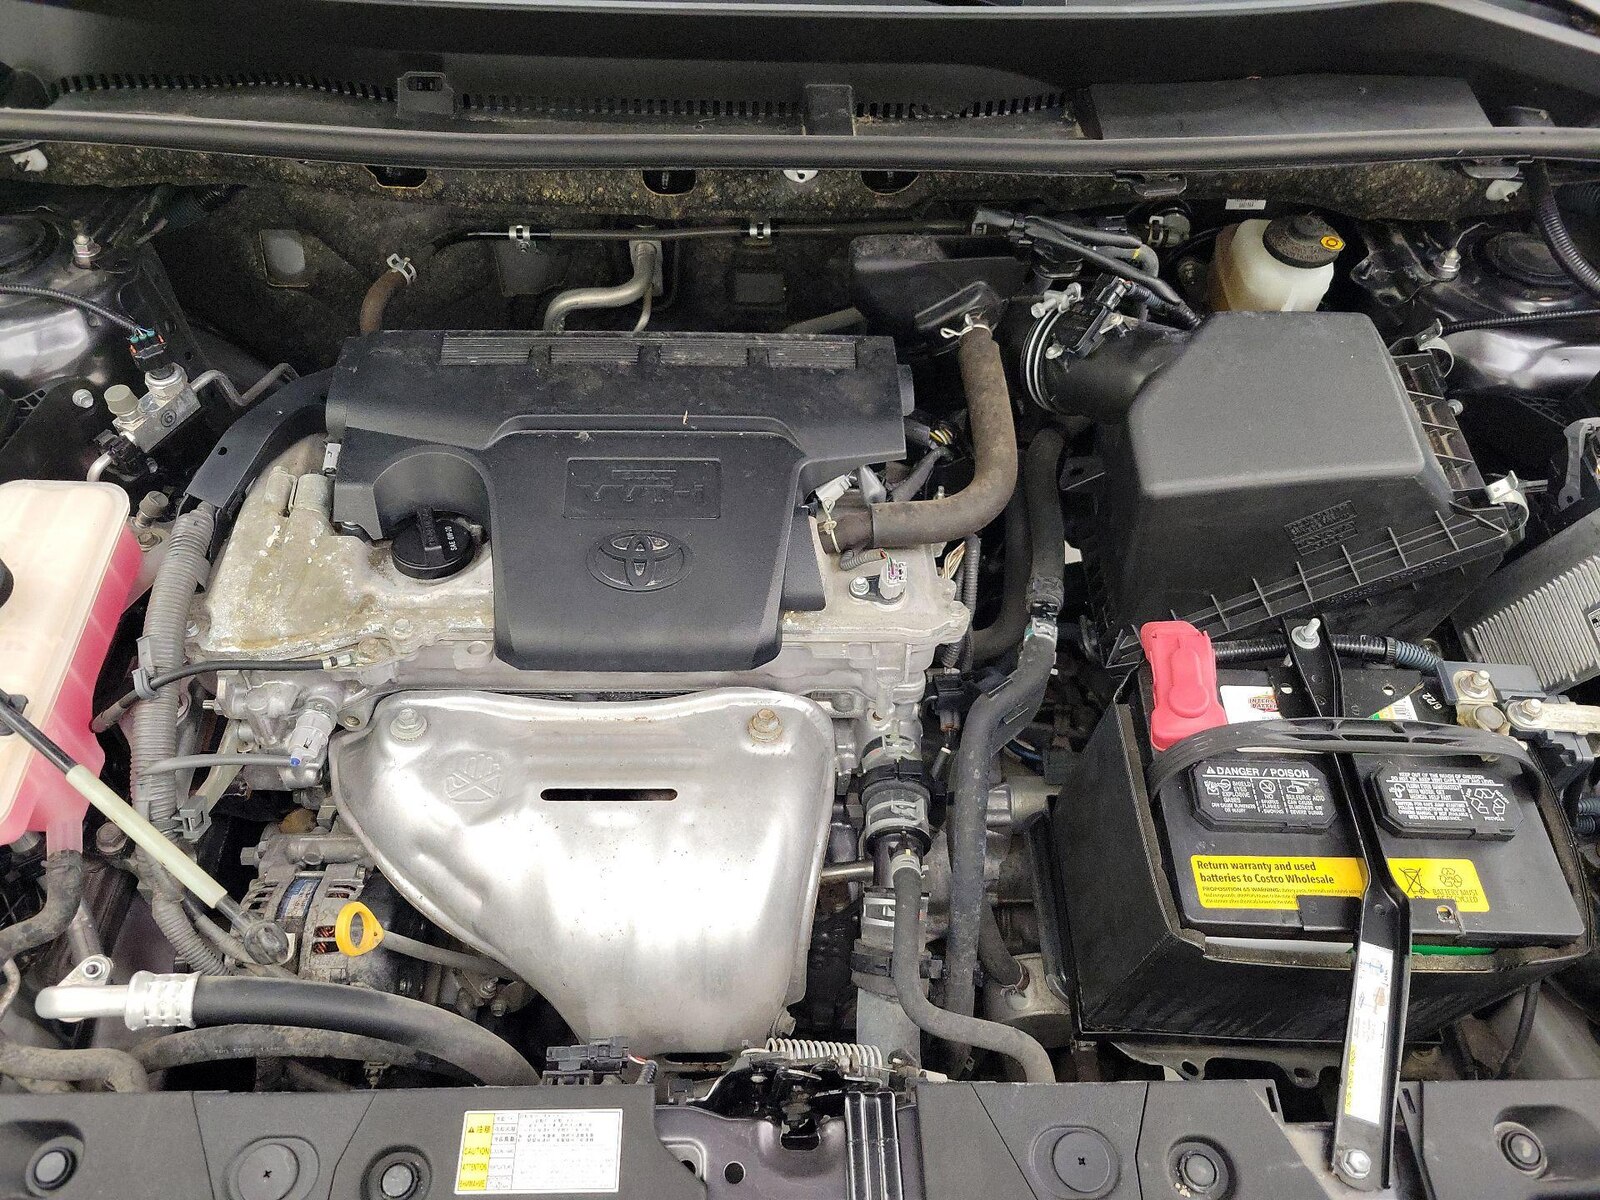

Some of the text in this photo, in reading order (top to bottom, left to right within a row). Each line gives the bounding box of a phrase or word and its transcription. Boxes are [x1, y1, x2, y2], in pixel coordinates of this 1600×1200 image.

[448, 541, 458, 551] SAE
[1422, 692, 1443, 710] 6/22
[1216, 766, 1260, 776] DANGER
[1270, 768, 1310, 778] POISON
[1197, 860, 1317, 873] Return warranty and used
[1200, 873, 1335, 884] batteries to Costco Wholesale
[1432, 888, 1459, 896] BATTERY
